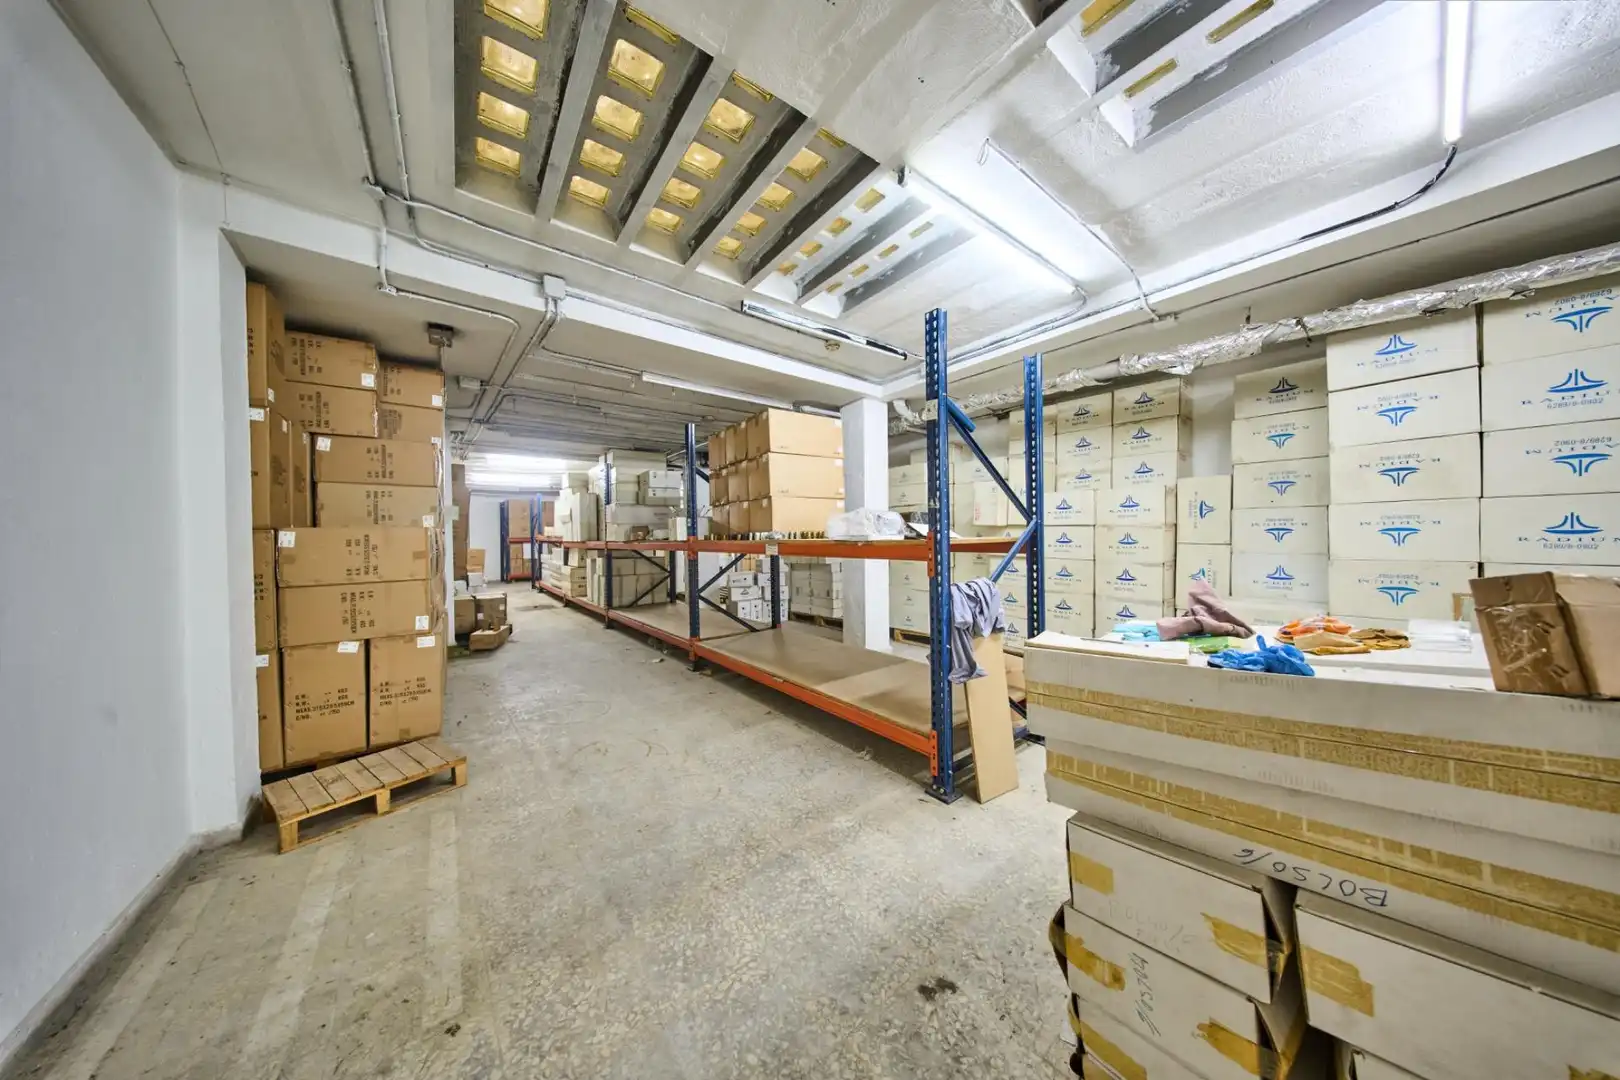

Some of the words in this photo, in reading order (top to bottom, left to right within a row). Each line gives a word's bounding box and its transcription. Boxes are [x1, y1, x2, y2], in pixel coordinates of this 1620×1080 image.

[1524, 293, 1620, 318] ADIUM
[1519, 388, 1620, 405] RADIU
[1523, 442, 1620, 455] ADIUM
